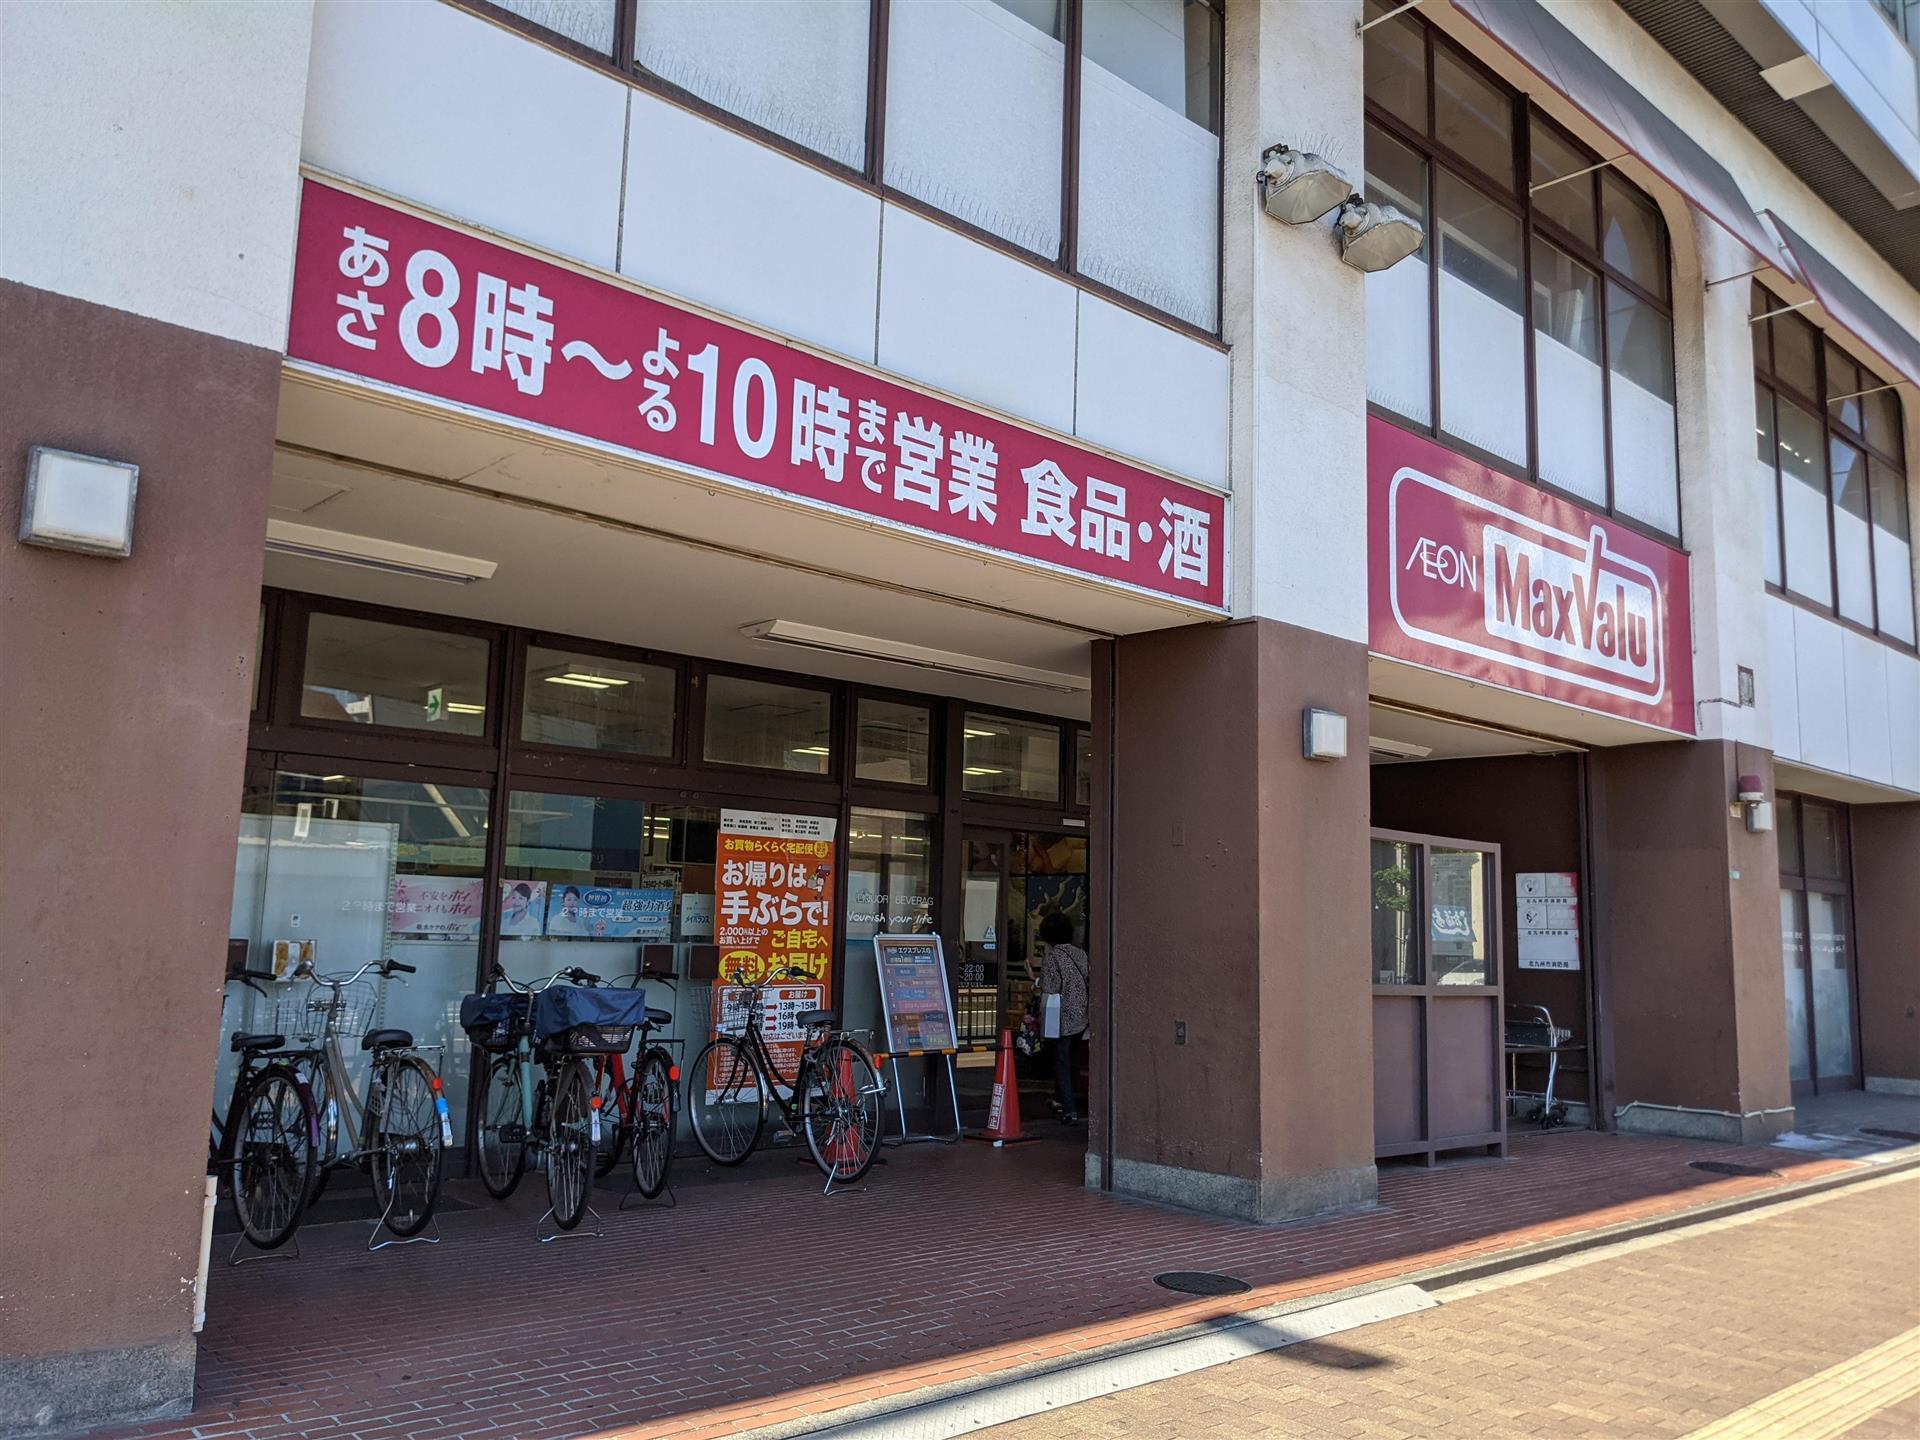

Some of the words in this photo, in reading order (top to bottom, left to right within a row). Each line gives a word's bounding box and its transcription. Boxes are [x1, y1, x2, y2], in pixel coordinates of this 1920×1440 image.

[1019, 458, 1211, 587] 食品・酒
[1494, 534, 1648, 669] MaxValu
[721, 860, 807, 888] お帰りは
[847, 911, 886, 923] Nourish
[889, 914, 913, 926] your
[916, 914, 934, 924] life
[770, 928, 829, 949] ご自宅へ
